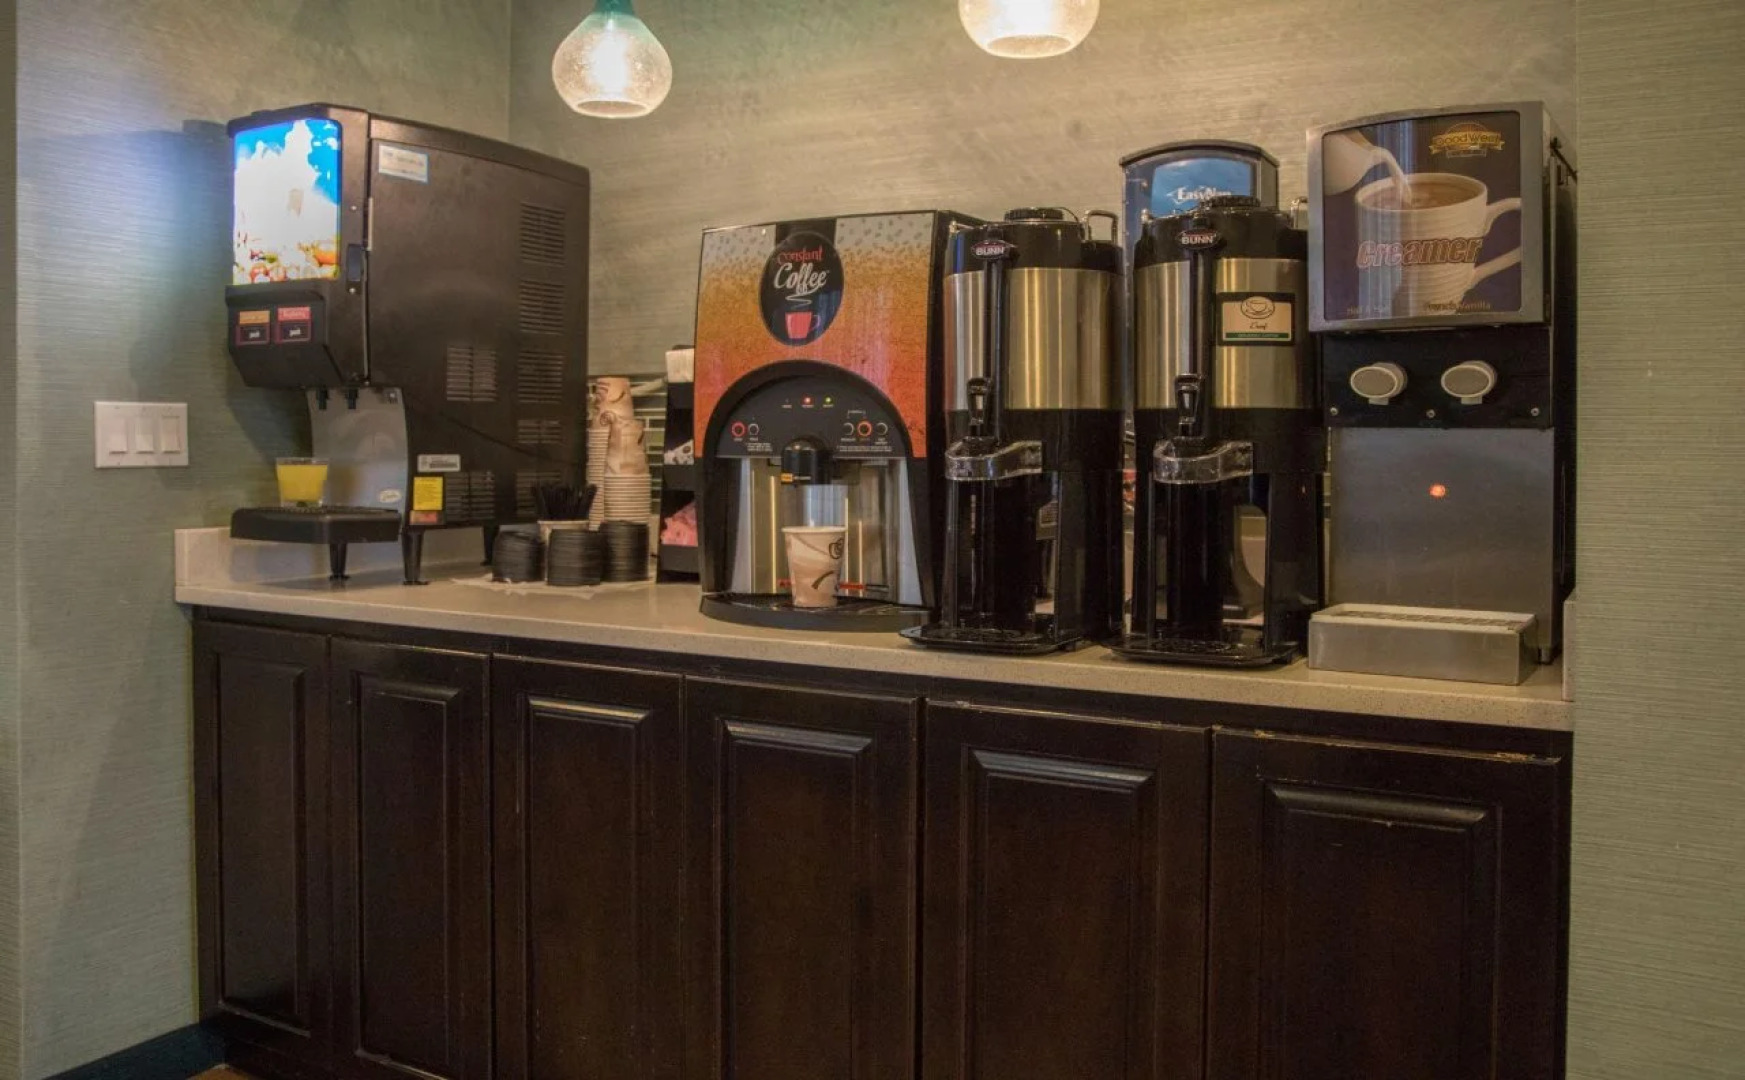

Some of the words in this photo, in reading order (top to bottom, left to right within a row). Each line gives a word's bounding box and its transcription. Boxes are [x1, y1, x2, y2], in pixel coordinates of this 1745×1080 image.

[1181, 235, 1214, 246] BUNN
[975, 246, 1004, 257] BUNN
[773, 262, 827, 294] Coffee
